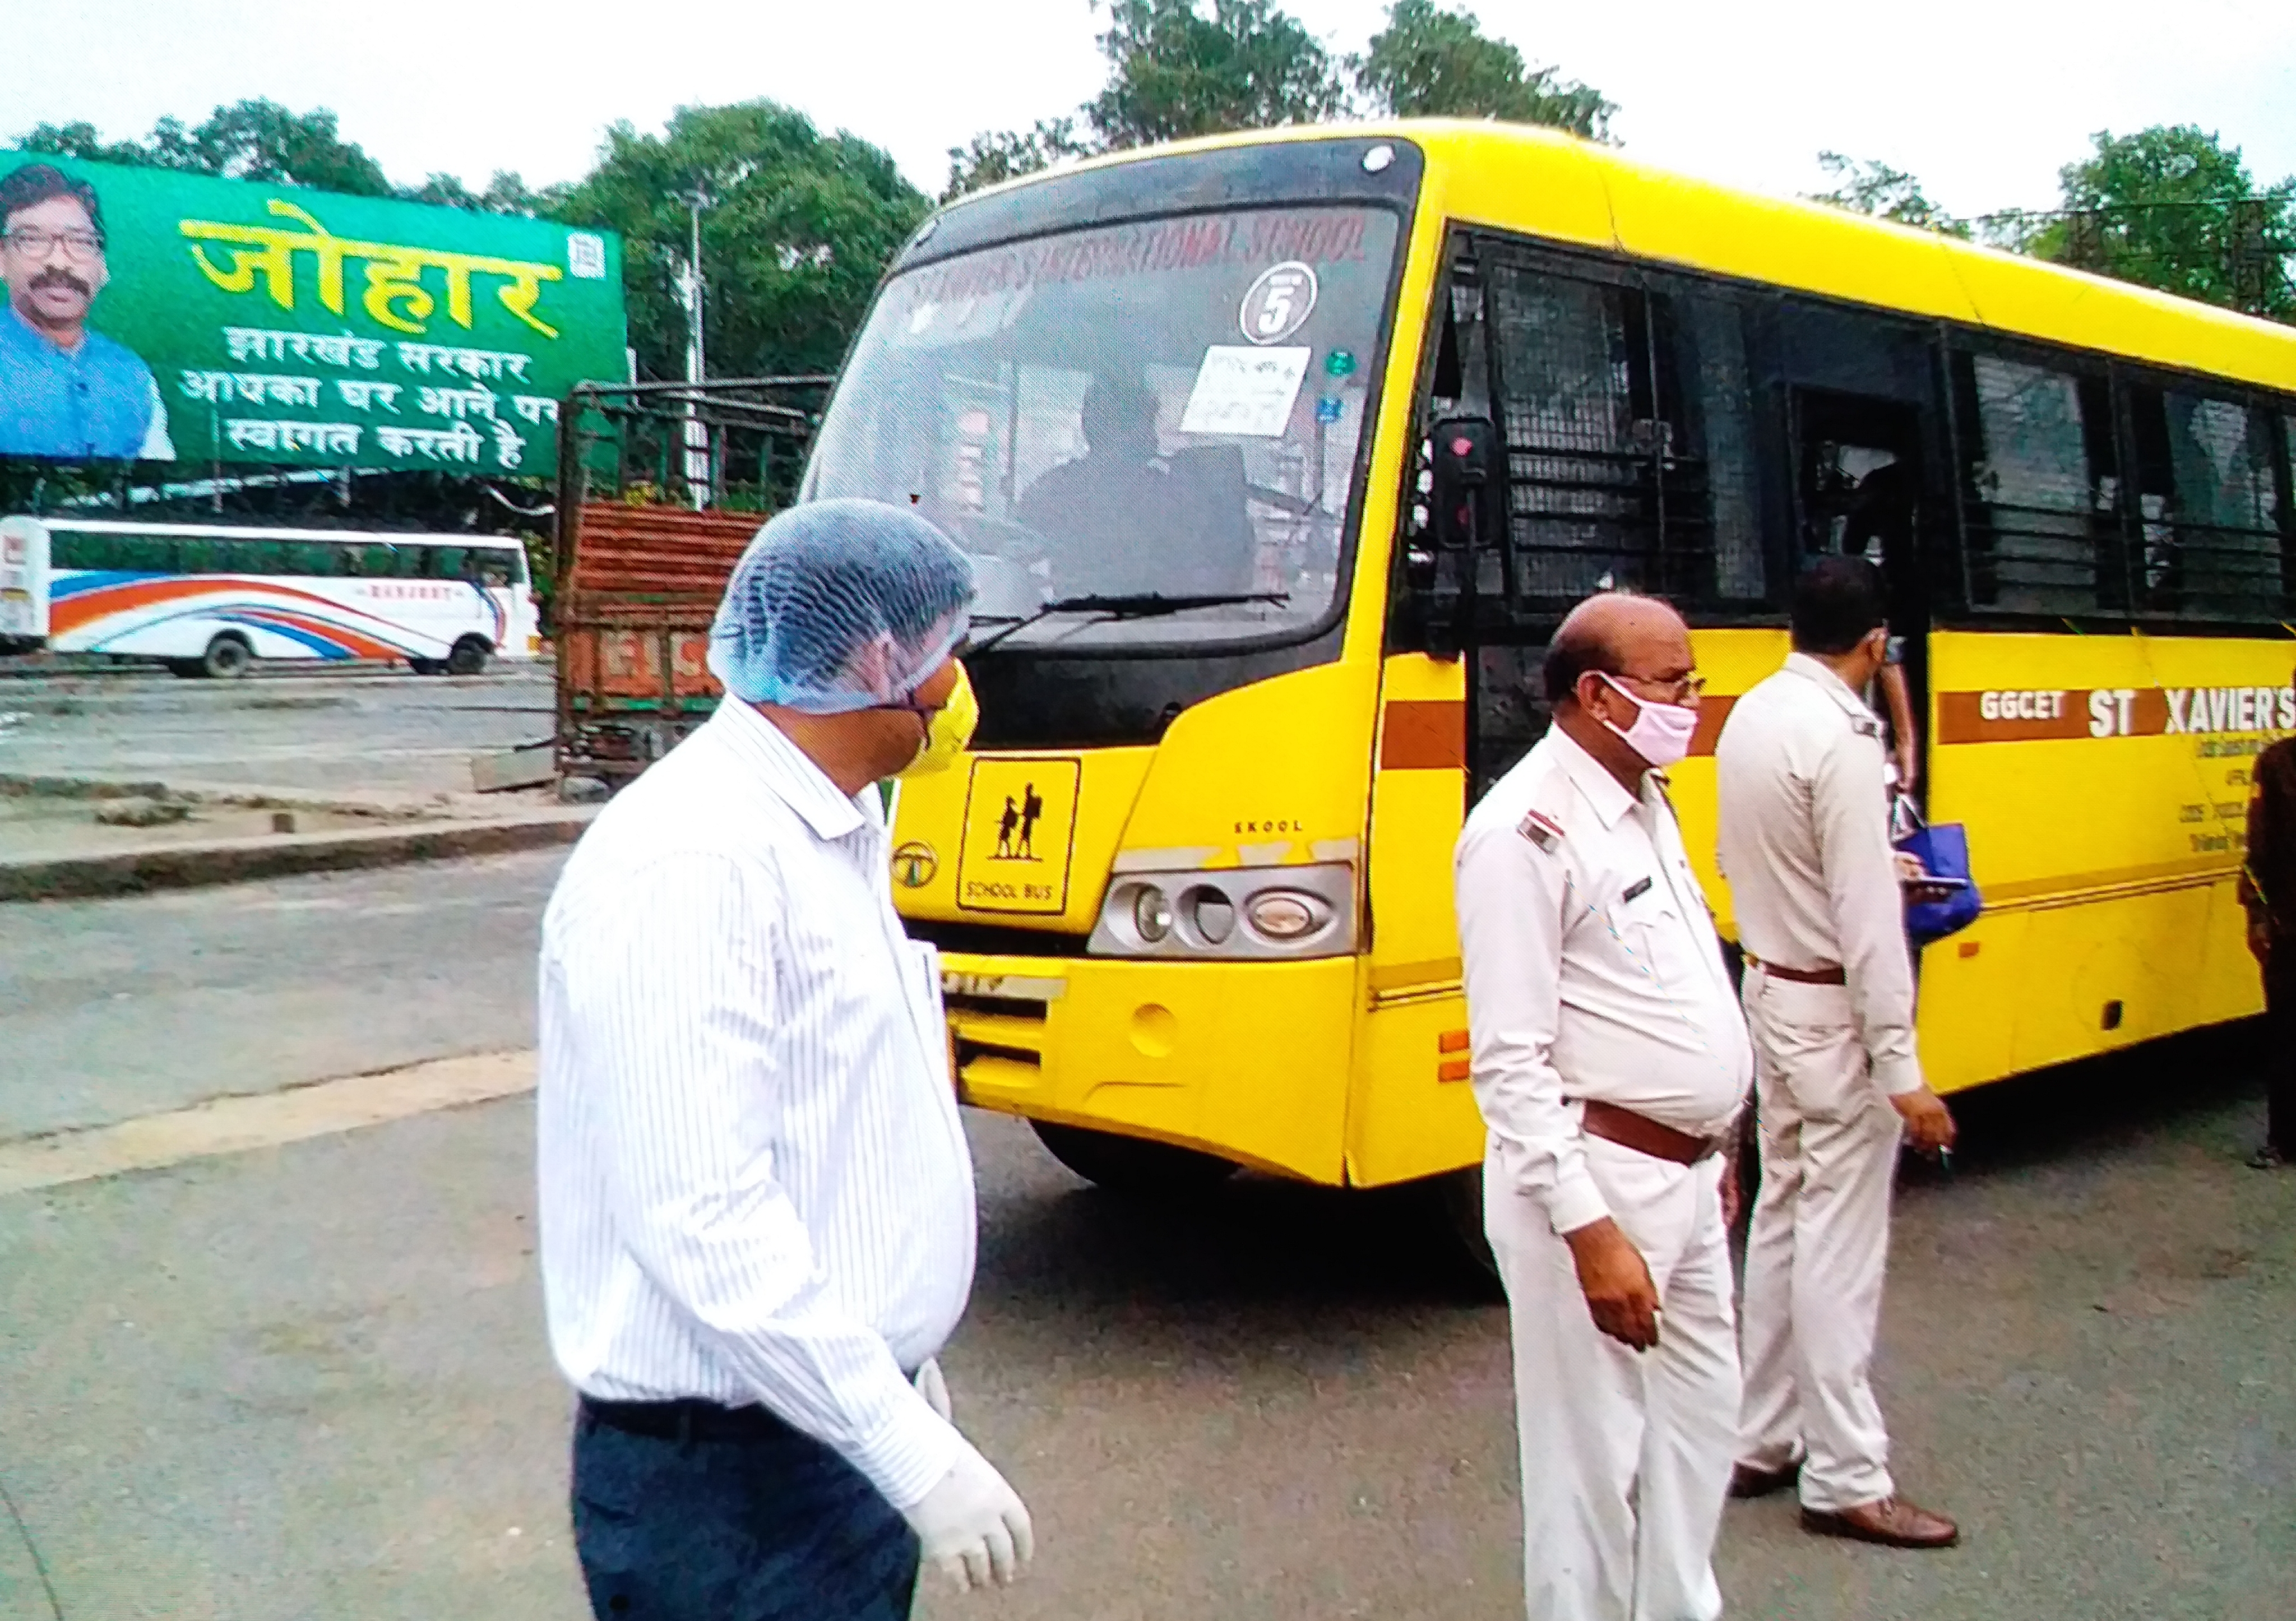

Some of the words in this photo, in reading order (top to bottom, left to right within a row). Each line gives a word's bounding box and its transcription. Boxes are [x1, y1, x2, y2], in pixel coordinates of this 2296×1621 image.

[179, 198, 563, 339] जोहार
[1258, 287, 1295, 334] 5
[221, 326, 387, 369] झारखंड
[395, 341, 533, 385] सरकार
[178, 369, 323, 408] आपका
[335, 379, 404, 415] घर
[415, 381, 501, 422] आने
[225, 418, 364, 455] स्वागत
[374, 420, 485, 464] करती
[490, 419, 528, 470] है
[1981, 691, 2067, 720] GGCET
[2089, 689, 2135, 738] ST
[2164, 687, 2296, 734] XAVIER'S
[966, 881, 1017, 899] SCHOOL
[1023, 883, 1053, 900] BUS
